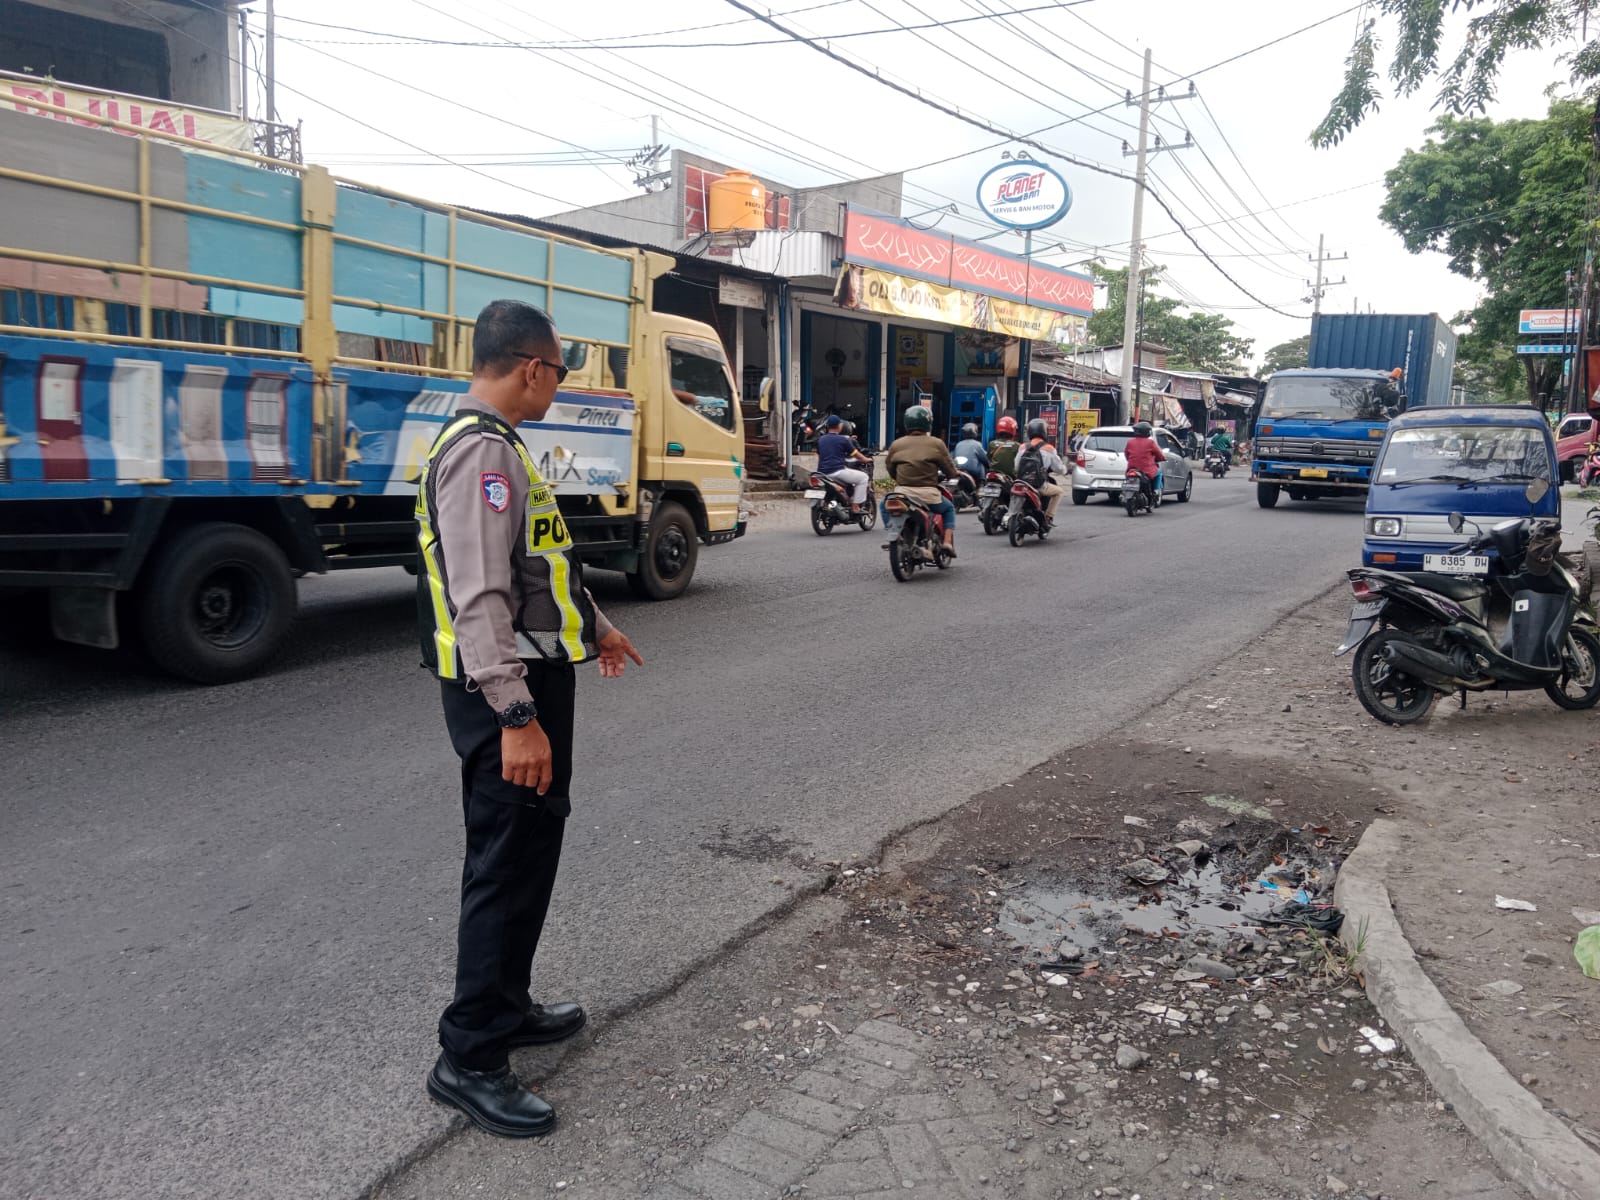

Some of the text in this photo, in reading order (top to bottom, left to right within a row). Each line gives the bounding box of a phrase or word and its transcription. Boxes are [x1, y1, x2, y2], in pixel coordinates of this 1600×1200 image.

[997, 172, 1046, 200] PLANET
[1023, 190, 1041, 201] BAN
[1019, 205, 1032, 213] BAN
[1032, 204, 1055, 212] MOTOR
[577, 407, 620, 427] Pintu
[1425, 555, 1488, 568] W 8385 DW
